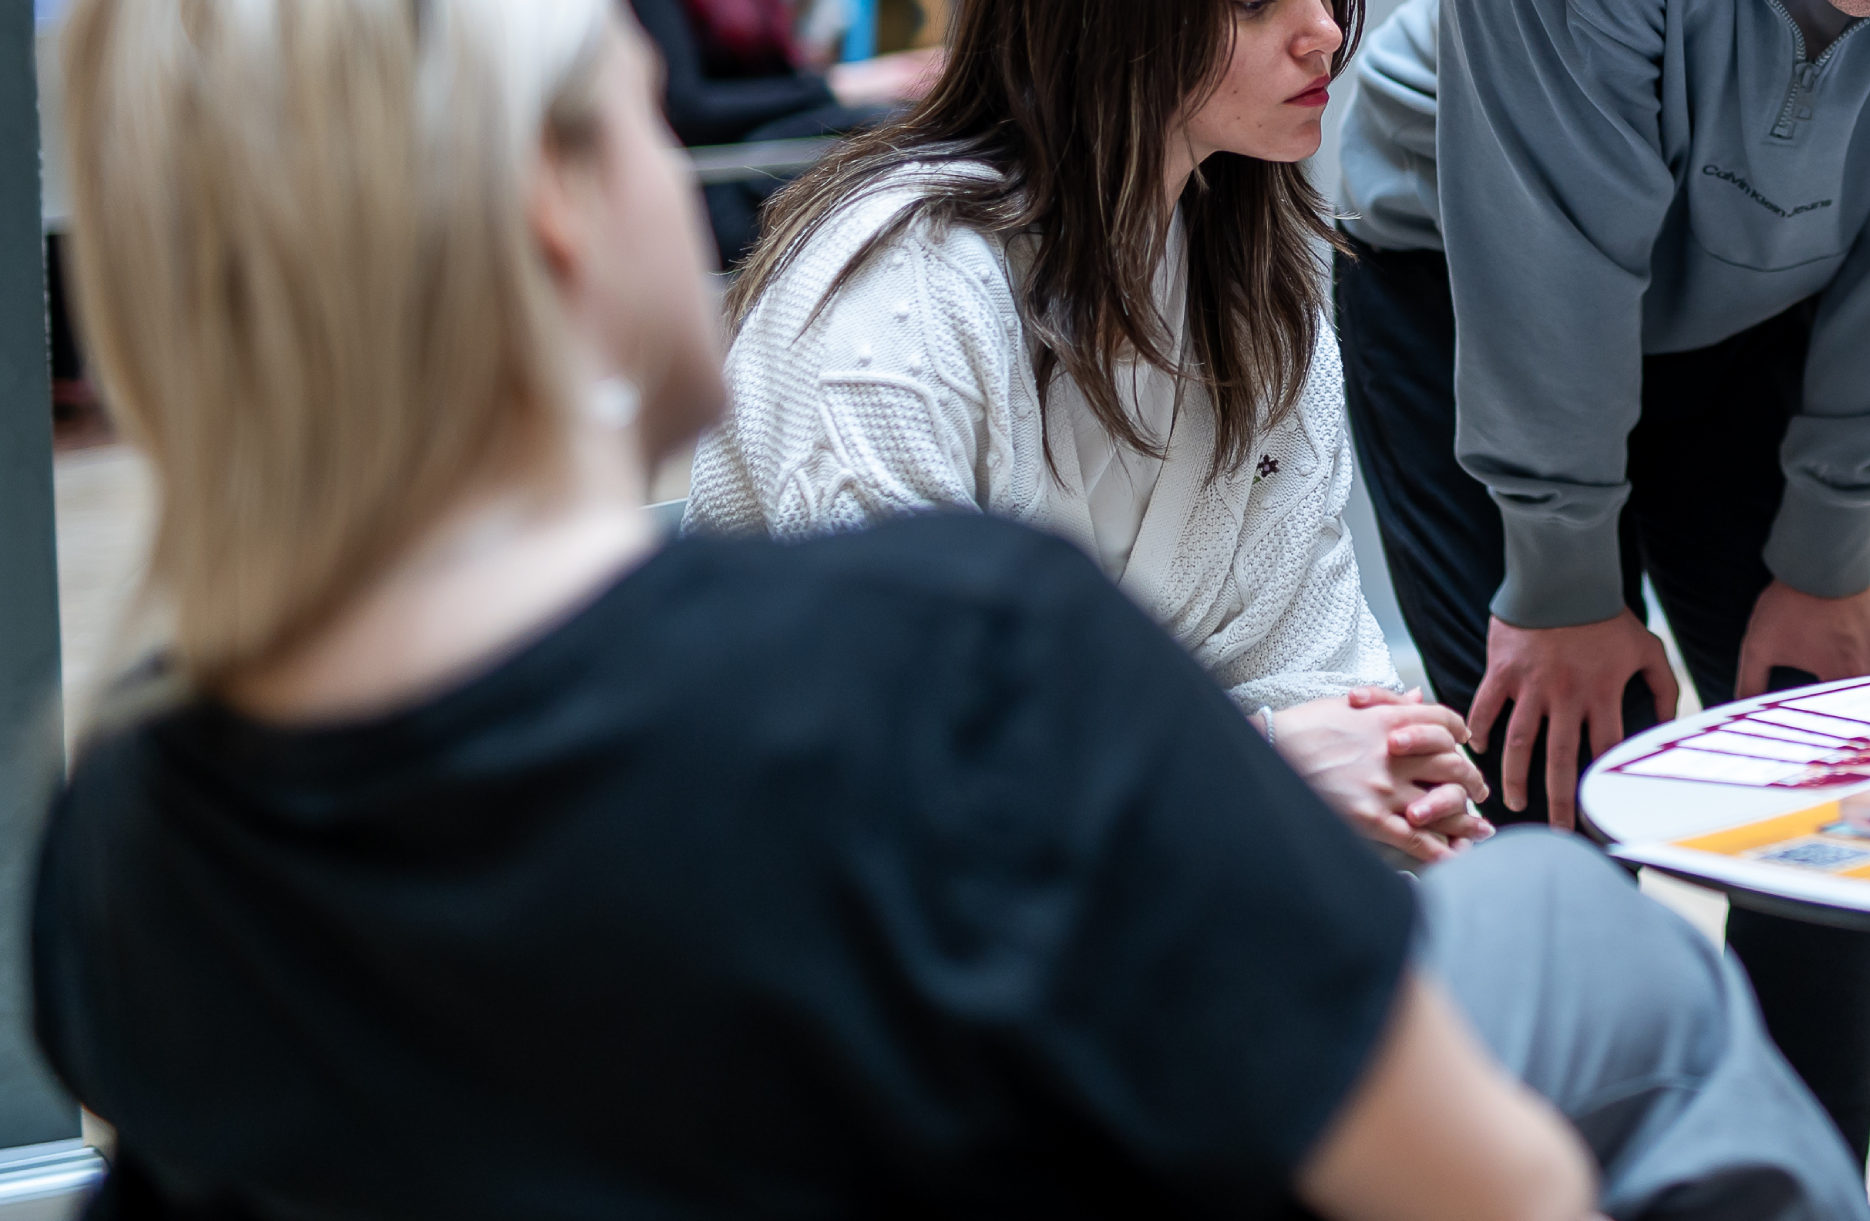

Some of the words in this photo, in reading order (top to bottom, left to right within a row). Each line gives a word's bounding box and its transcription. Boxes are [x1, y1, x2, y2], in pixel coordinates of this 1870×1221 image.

[1702, 164, 1751, 194] Calvin
[1750, 190, 1786, 217] Klein
[1787, 199, 1832, 217] Jeans
